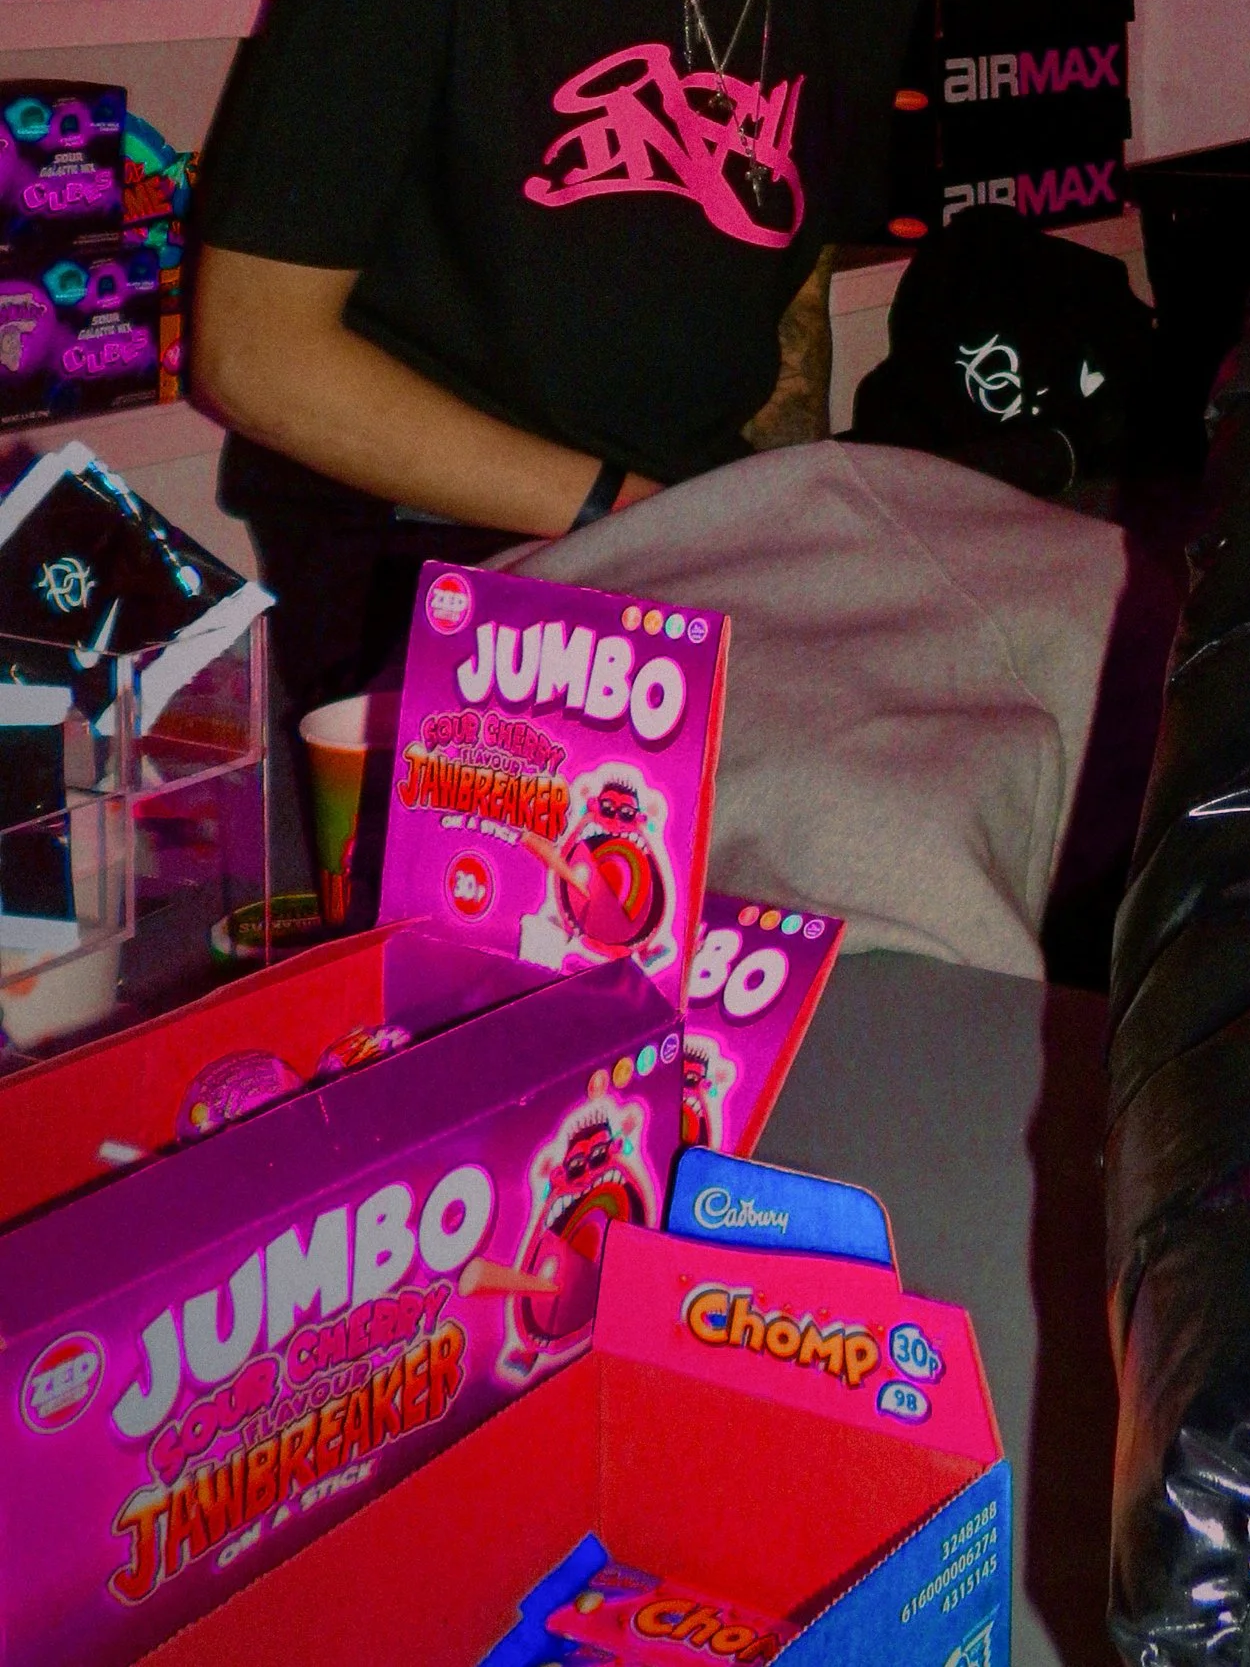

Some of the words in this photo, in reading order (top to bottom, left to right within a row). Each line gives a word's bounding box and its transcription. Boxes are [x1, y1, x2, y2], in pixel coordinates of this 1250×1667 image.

[457, 621, 686, 742] JUMBO
[422, 710, 482, 753] SOUR
[484, 711, 567, 778] CHERRY
[461, 749, 523, 775] FLAVOUR
[398, 742, 571, 842] JAWBREAKER
[694, 1187, 790, 1234] Cadbury
[111, 1167, 497, 1438] JUMBO
[149, 1353, 281, 1485] SOUR
[286, 1280, 453, 1388] CHERRY
[895, 1333, 939, 1377] 30p
[242, 1359, 372, 1448] FLAVOUR
[893, 1389, 918, 1412] 98
[108, 1319, 467, 1606] JAWBREAKER
[216, 1521, 262, 1570] ON
[271, 1504, 291, 1530] A
[301, 1458, 378, 1512] STICK
[942, 1500, 997, 1562] 3248288
[901, 1527, 997, 1624] 616000006274
[942, 1554, 997, 1615] 4315145
